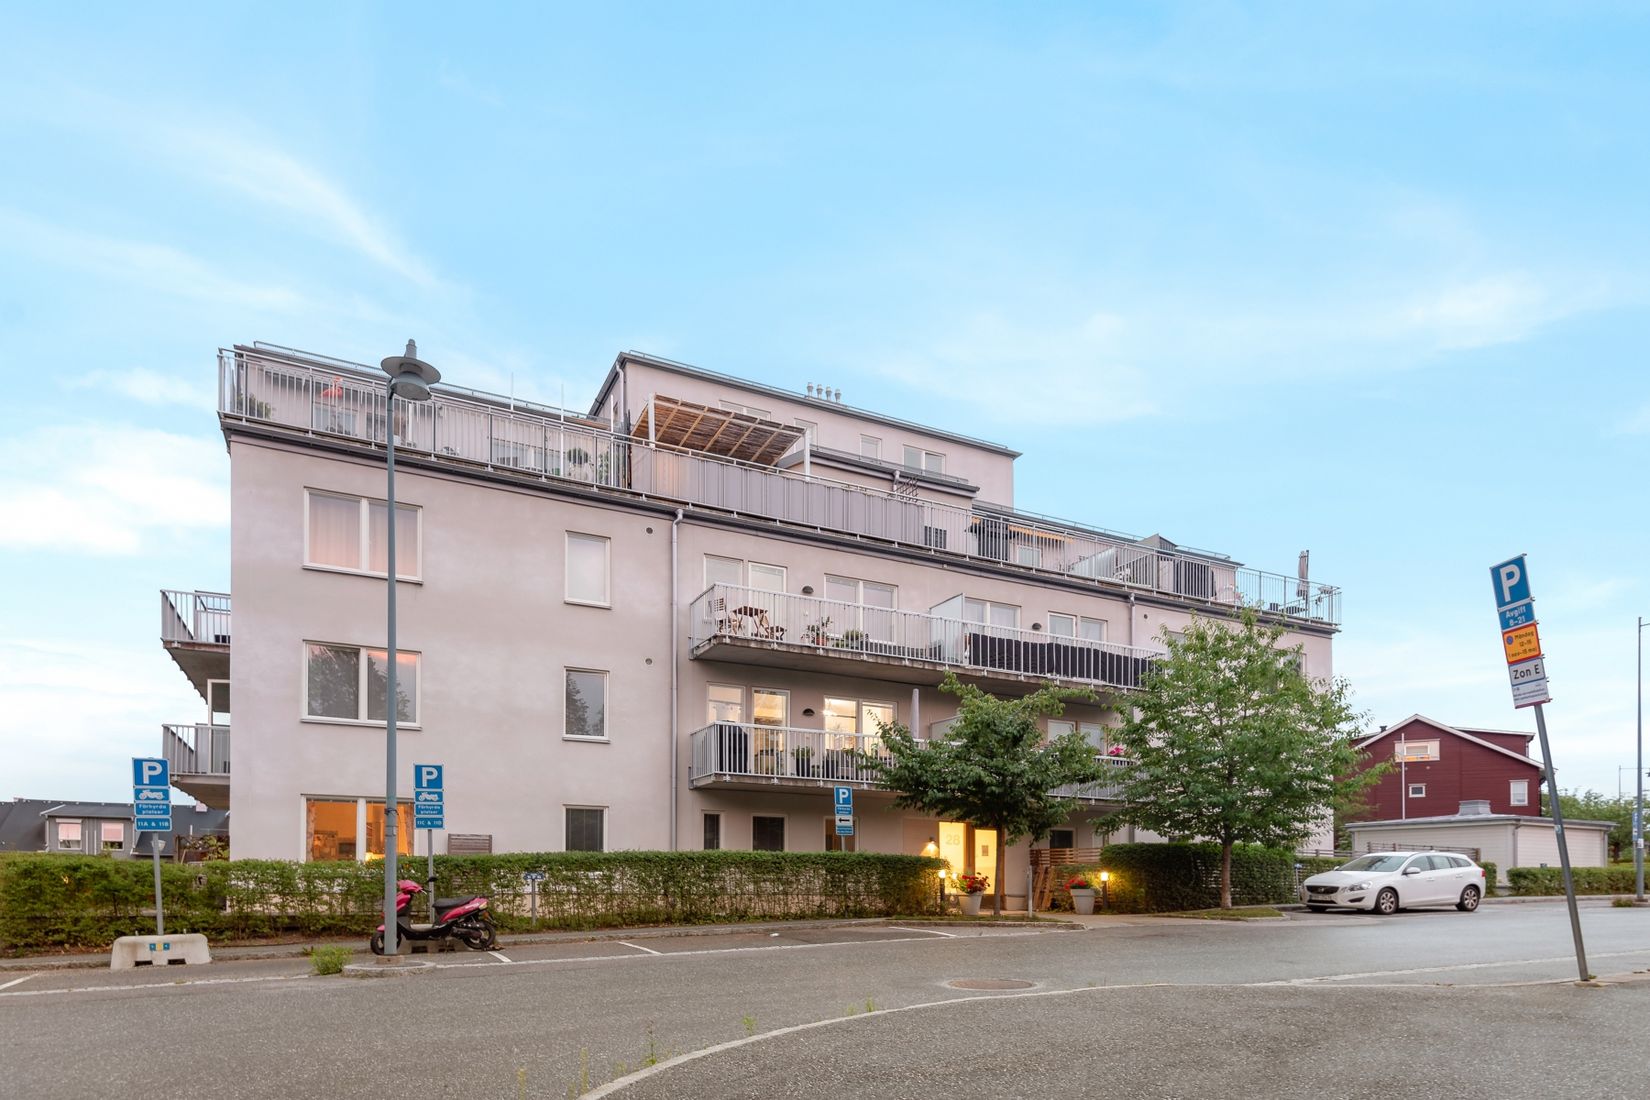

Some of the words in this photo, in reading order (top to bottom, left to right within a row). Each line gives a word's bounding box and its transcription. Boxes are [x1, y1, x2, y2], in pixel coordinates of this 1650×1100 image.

[1499, 563, 1521, 602] P
[1506, 606, 1526, 618] Avgift
[1513, 669, 1531, 679] Zon
[1534, 664, 1540, 674] E
[142, 761, 162, 784] P
[421, 767, 438, 787] P
[839, 788, 849, 804] P
[945, 833, 961, 845] 28
